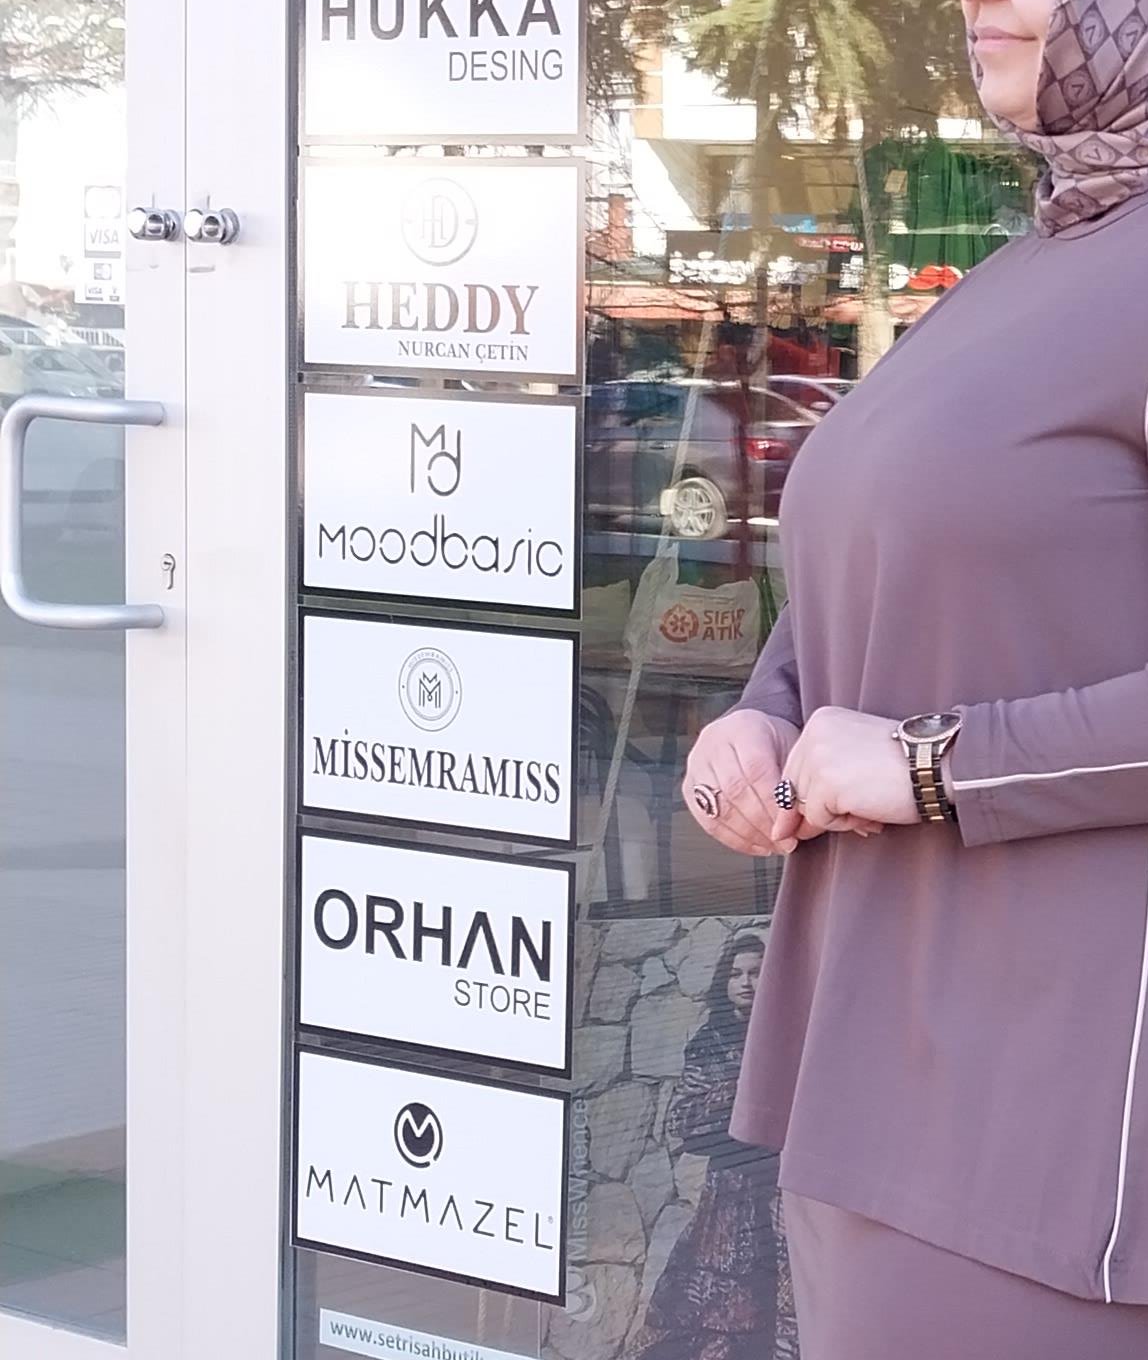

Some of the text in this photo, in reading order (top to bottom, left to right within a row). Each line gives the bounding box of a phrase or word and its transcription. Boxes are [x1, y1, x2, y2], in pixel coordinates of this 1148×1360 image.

[448, 48, 563, 82] DESING
[90, 229, 119, 244] VISA
[341, 281, 539, 337] HEDDY
[397, 340, 529, 364] NURCAN ÇETİN
[313, 888, 552, 982] ORHAN
[453, 978, 551, 1021] STORE
[306, 1165, 554, 1250] MATMAZEL
